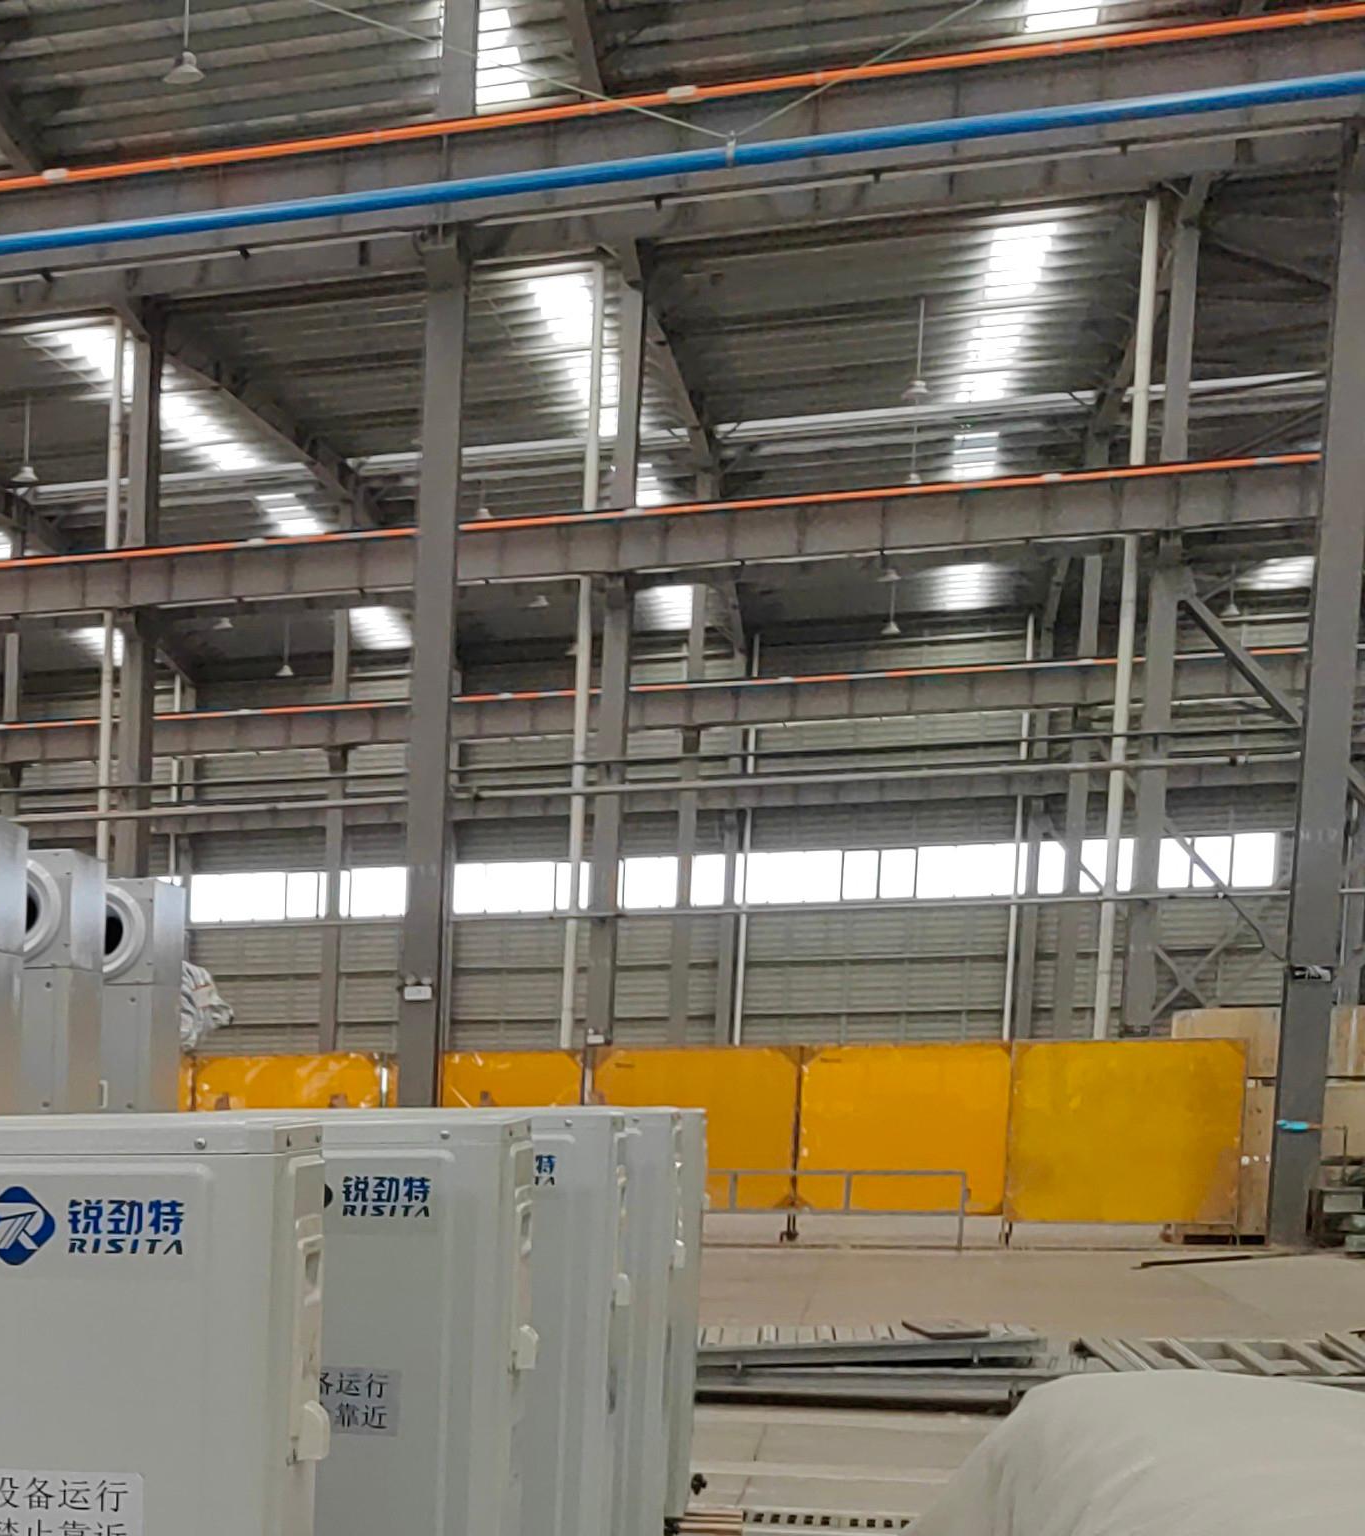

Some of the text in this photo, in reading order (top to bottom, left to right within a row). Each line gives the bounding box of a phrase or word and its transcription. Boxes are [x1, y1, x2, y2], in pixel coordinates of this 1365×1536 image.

[342, 1175, 432, 1203] 锐劲特
[68, 1199, 185, 1235] 锐劲特
[342, 1204, 431, 1217] RISITA
[68, 1238, 184, 1255] RISITA
